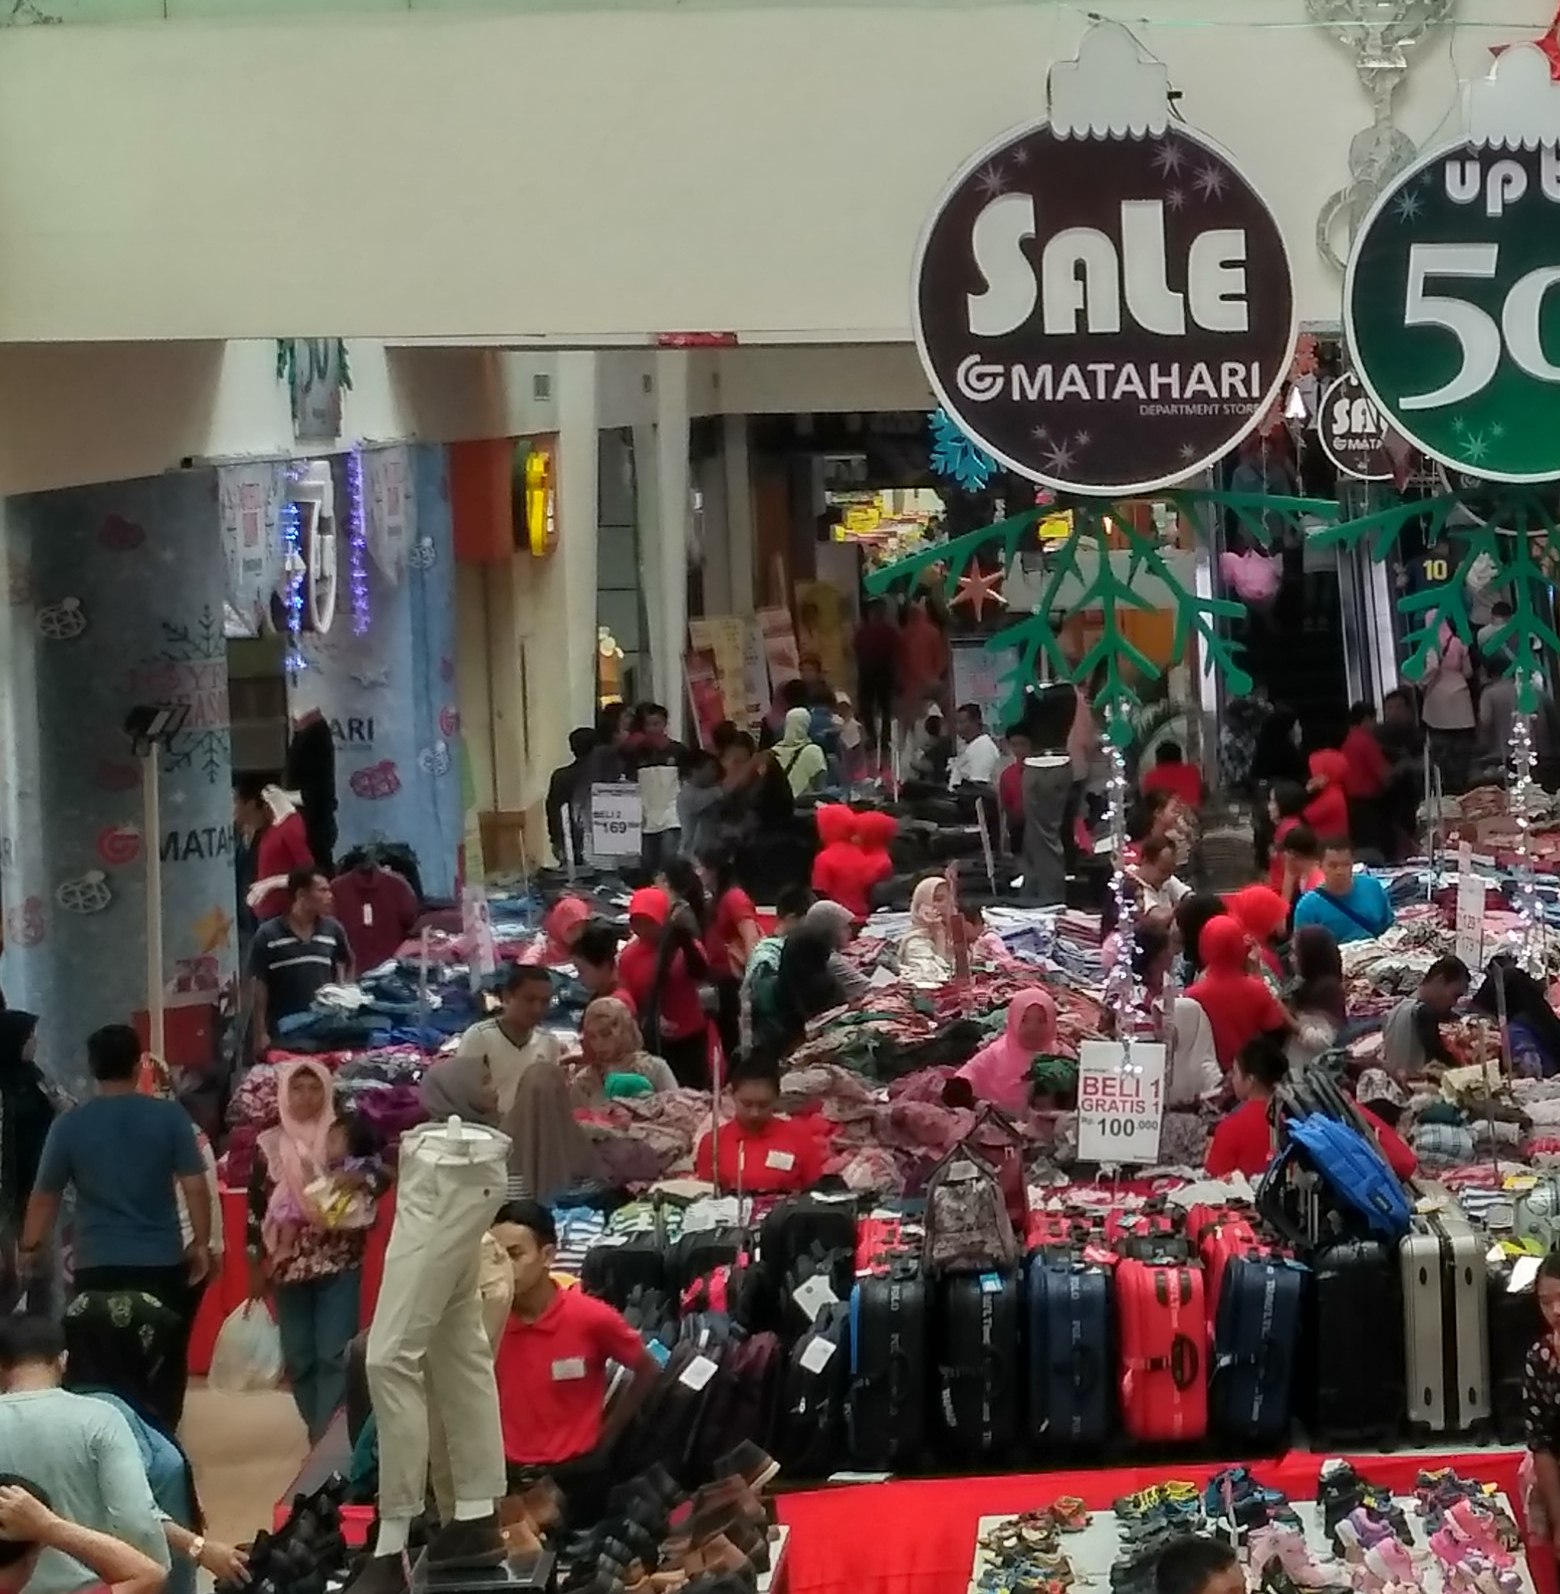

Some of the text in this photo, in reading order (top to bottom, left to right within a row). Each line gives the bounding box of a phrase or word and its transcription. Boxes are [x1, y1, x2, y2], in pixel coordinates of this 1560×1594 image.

[1445, 160, 1527, 217] up
[966, 192, 1249, 336] SALE
[1011, 362, 1260, 401] MATAHARI
[1139, 403, 1260, 416] DEPARTMENT STORE
[1423, 559, 1447, 580] 10
[1082, 1076, 1160, 1098] BELI 1
[1081, 1098, 1159, 1115] GRATIS 1
